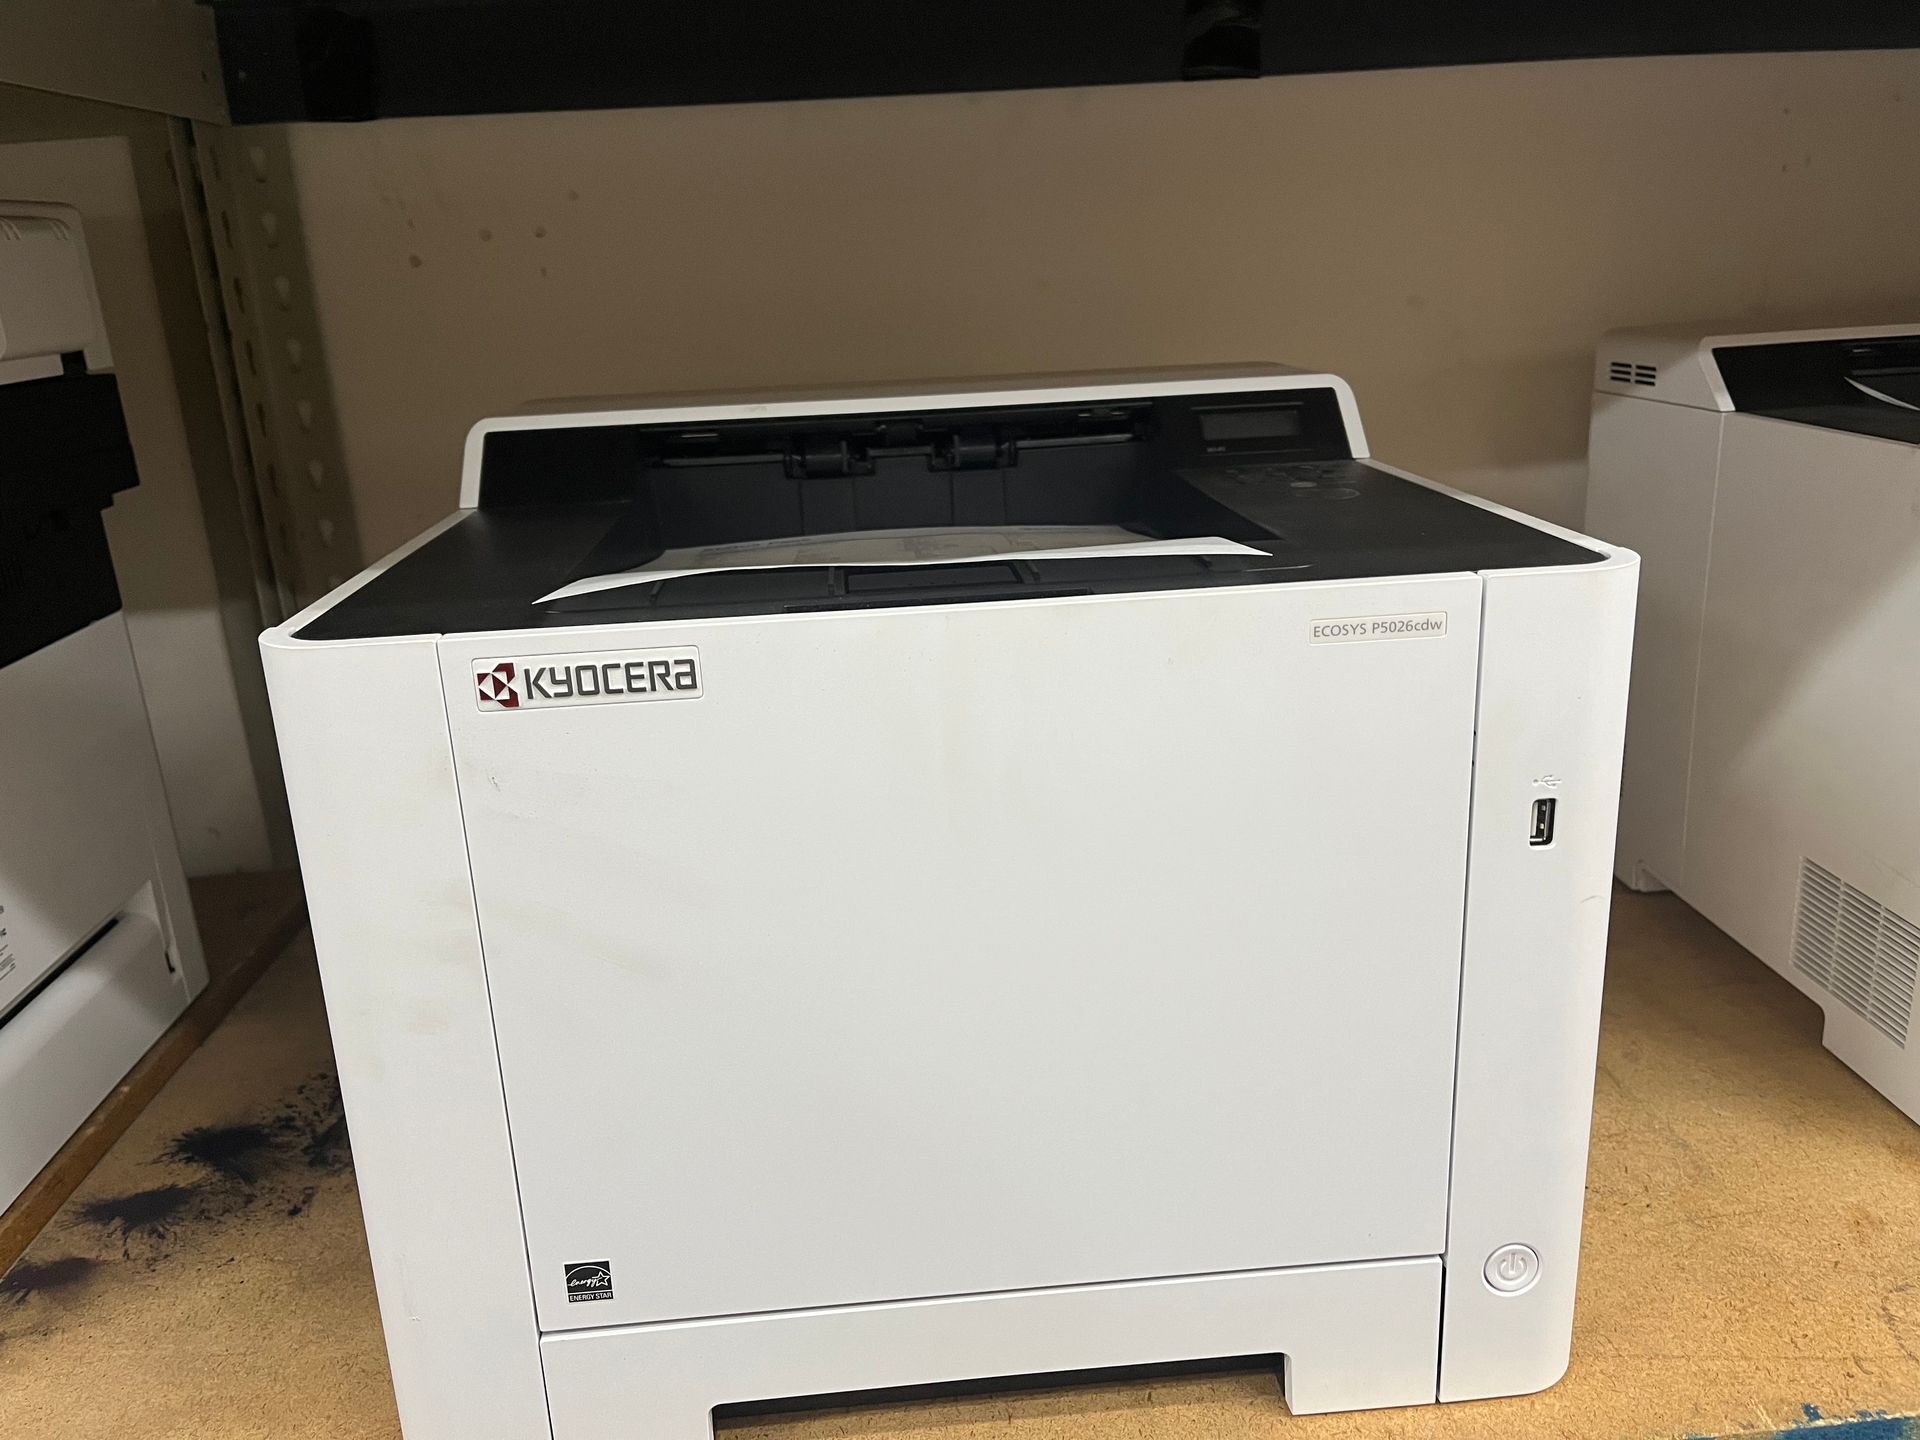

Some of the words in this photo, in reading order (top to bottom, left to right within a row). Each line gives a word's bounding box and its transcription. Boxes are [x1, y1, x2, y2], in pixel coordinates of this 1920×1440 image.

[1313, 623, 1367, 638] ECOSYS
[1372, 618, 1443, 634] P5026cdw
[523, 658, 698, 700] KYOCERA
[569, 1293, 595, 1302] ENERGY
[595, 1292, 612, 1300] STAR
